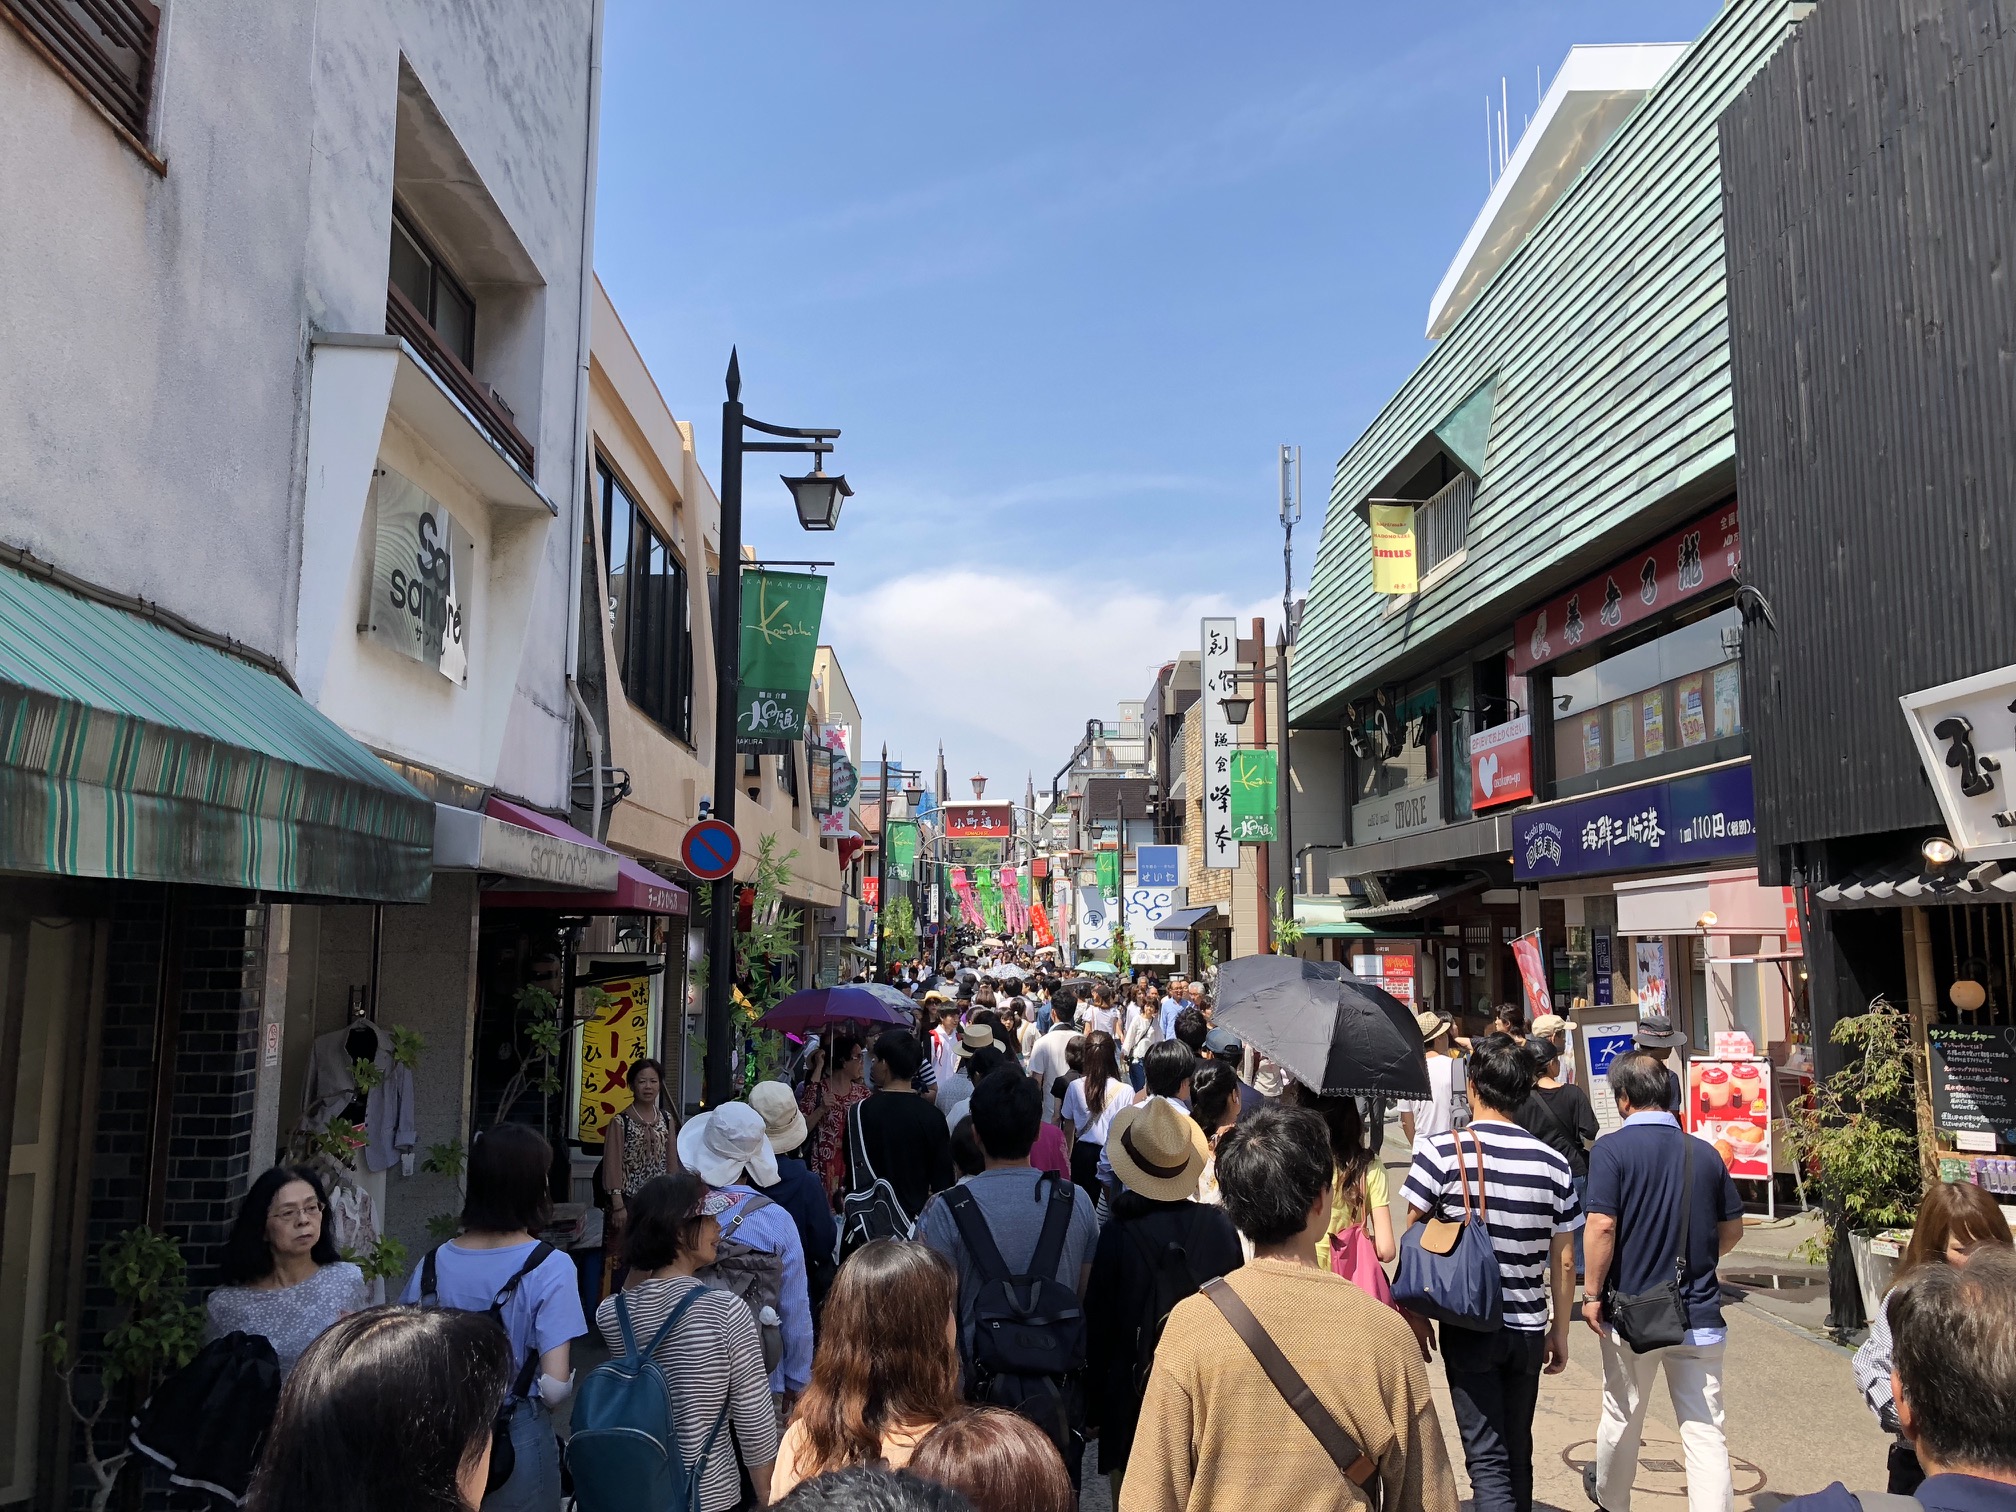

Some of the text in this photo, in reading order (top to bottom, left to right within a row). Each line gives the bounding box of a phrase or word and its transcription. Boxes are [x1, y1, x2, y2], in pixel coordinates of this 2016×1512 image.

[1374, 546, 1412, 558] imus
[746, 579, 822, 591] KAMAKURA
[1563, 530, 1704, 646] 養老乃瀧
[1395, 795, 1428, 829] MORE
[954, 816, 1001, 830] 小町通り
[1524, 826, 1539, 846] Sushi
[1546, 822, 1563, 841] round
[1581, 806, 1666, 856] 海鮮三崎港
[1142, 871, 1176, 882] せいた
[1929, 1029, 1997, 1041] サンキャッチャー
